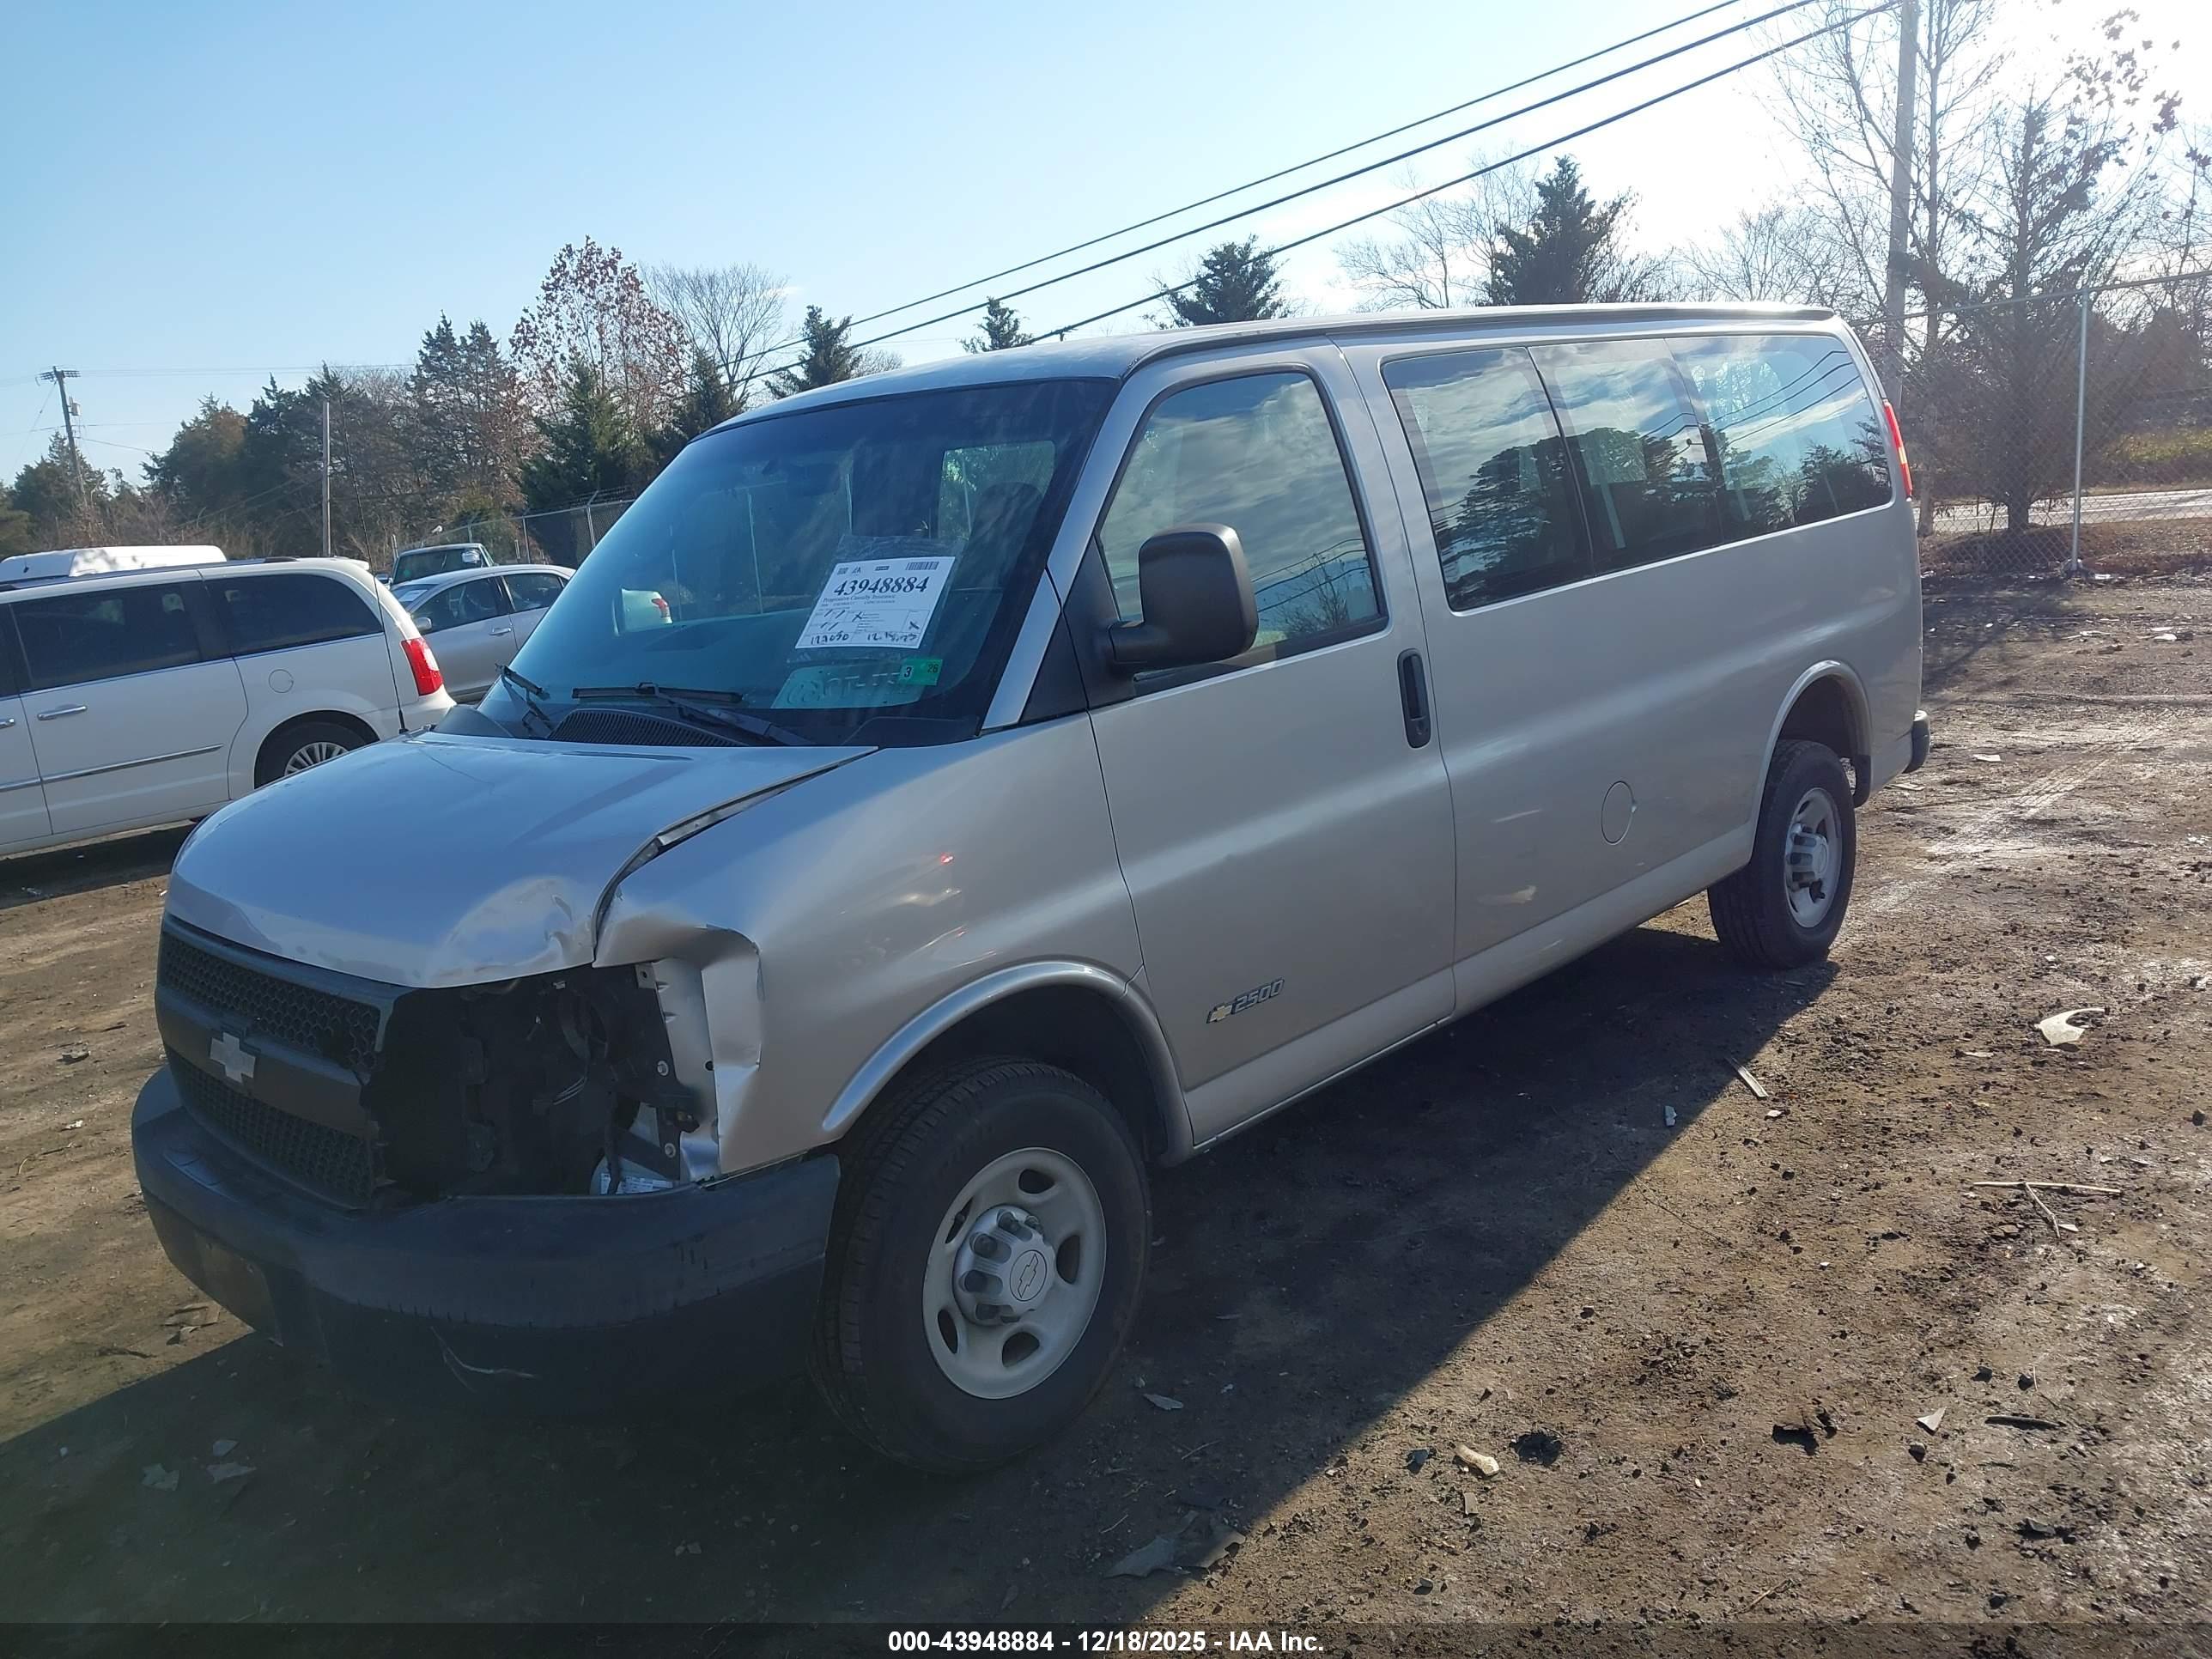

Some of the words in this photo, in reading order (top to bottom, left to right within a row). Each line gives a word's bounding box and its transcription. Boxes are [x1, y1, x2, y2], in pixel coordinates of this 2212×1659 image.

[834, 576, 929, 596] 43948884
[903, 666, 912, 678] 3
[927, 664, 939, 673] 26
[1231, 977, 1285, 1014] 2500
